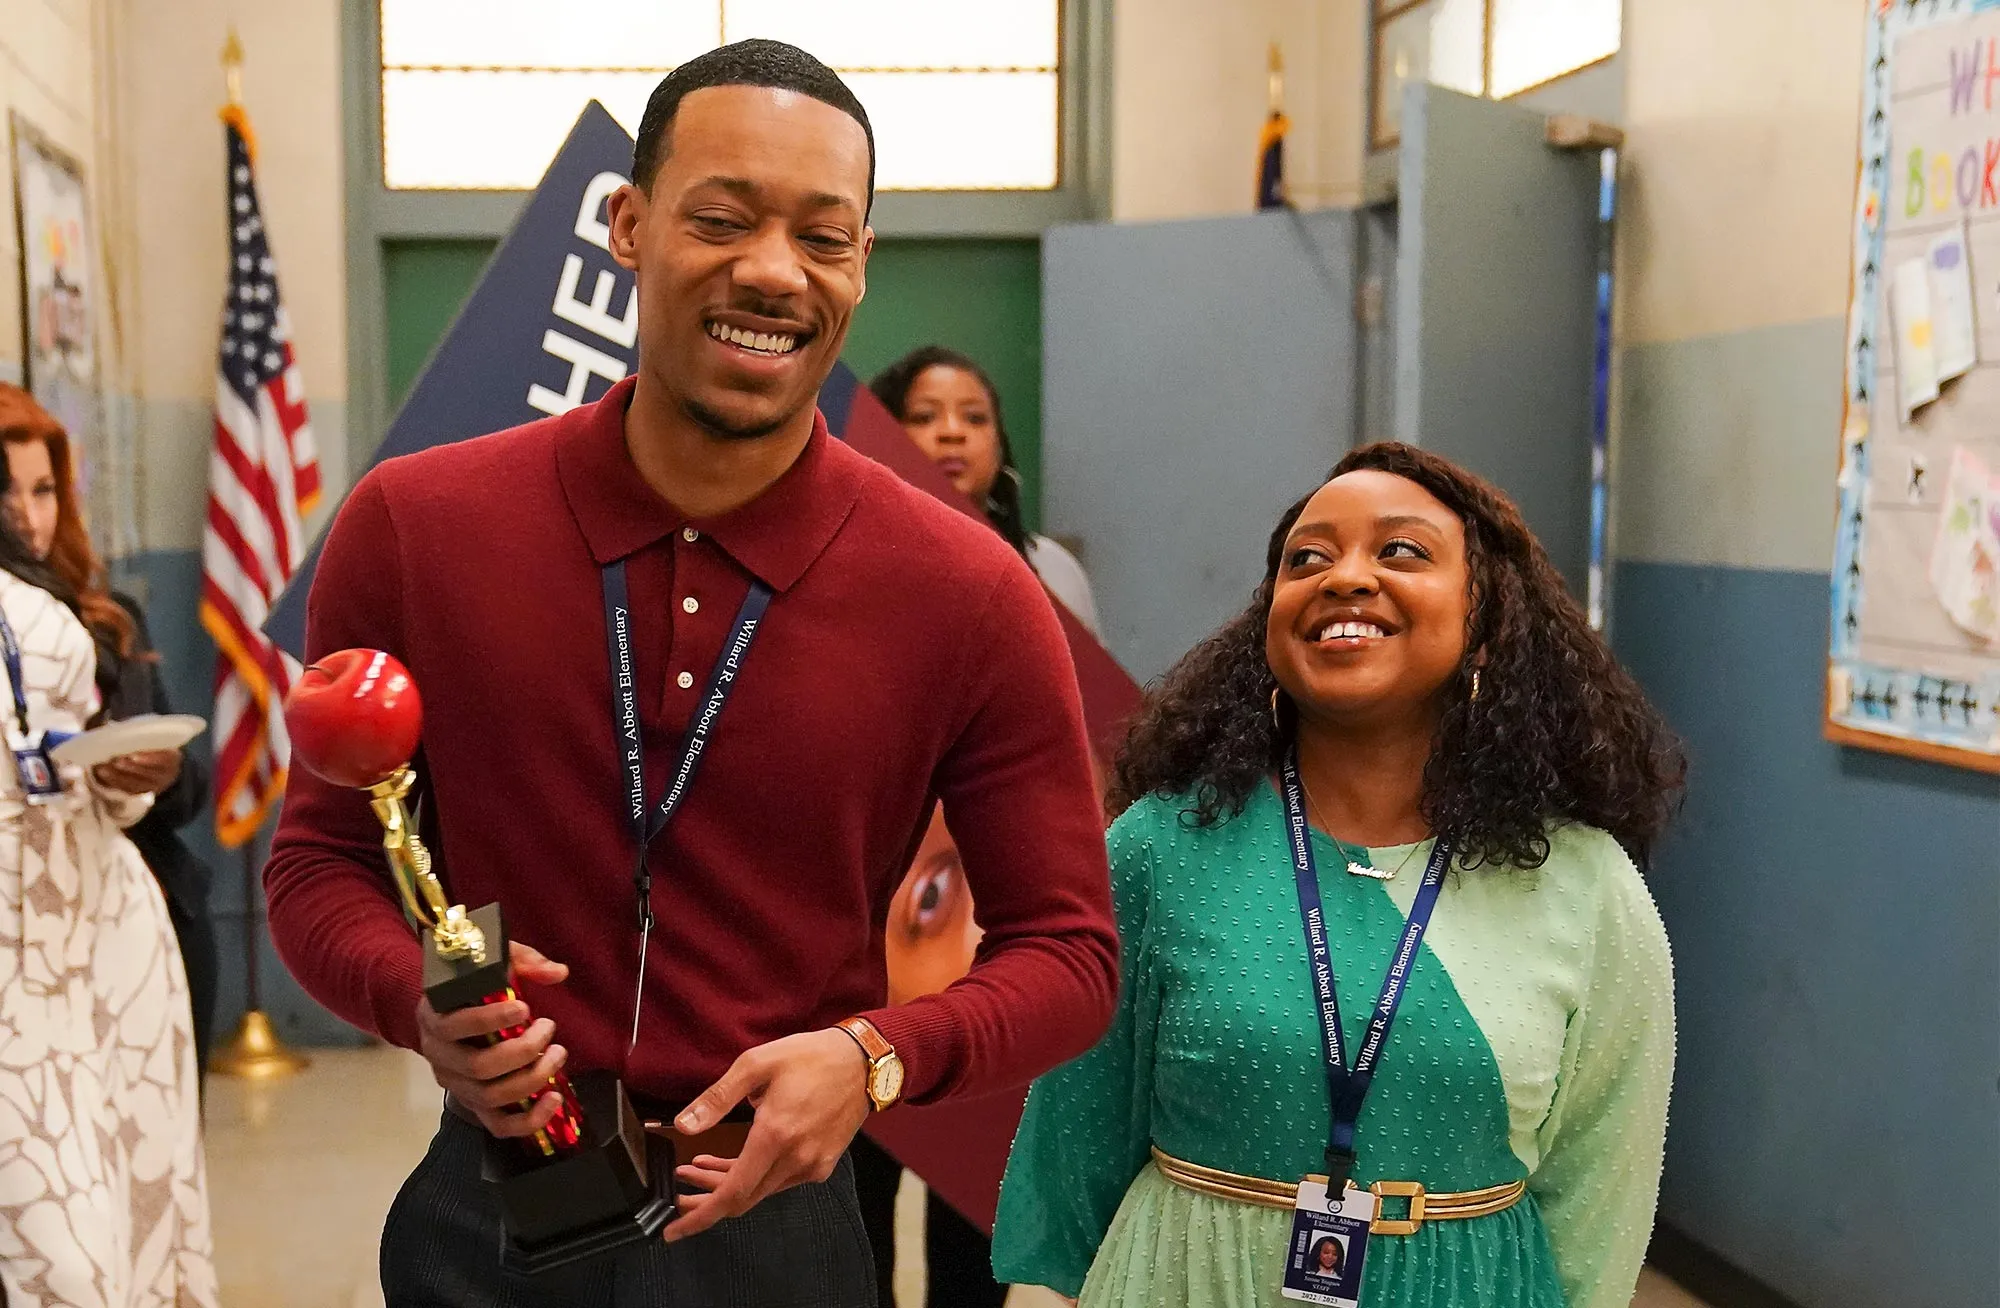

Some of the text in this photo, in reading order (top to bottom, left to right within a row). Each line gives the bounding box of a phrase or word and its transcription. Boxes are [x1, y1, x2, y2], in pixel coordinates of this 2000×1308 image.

[615, 606, 642, 819] Willard R. Abbott Elementary
[660, 619, 757, 814] Willard R. Abbott Elementary
[1287, 784, 1300, 814] Abbott
[1292, 816, 1309, 871] Elementary
[1423, 852, 1444, 886] Willard
[1307, 907, 1342, 1067] Willard R. Abbott Elementary
[1357, 922, 1422, 1073] Willard R. Abbott Elementary
[1306, 1212, 1330, 1222] Willard
[1314, 1220, 1350, 1233] Elementary
